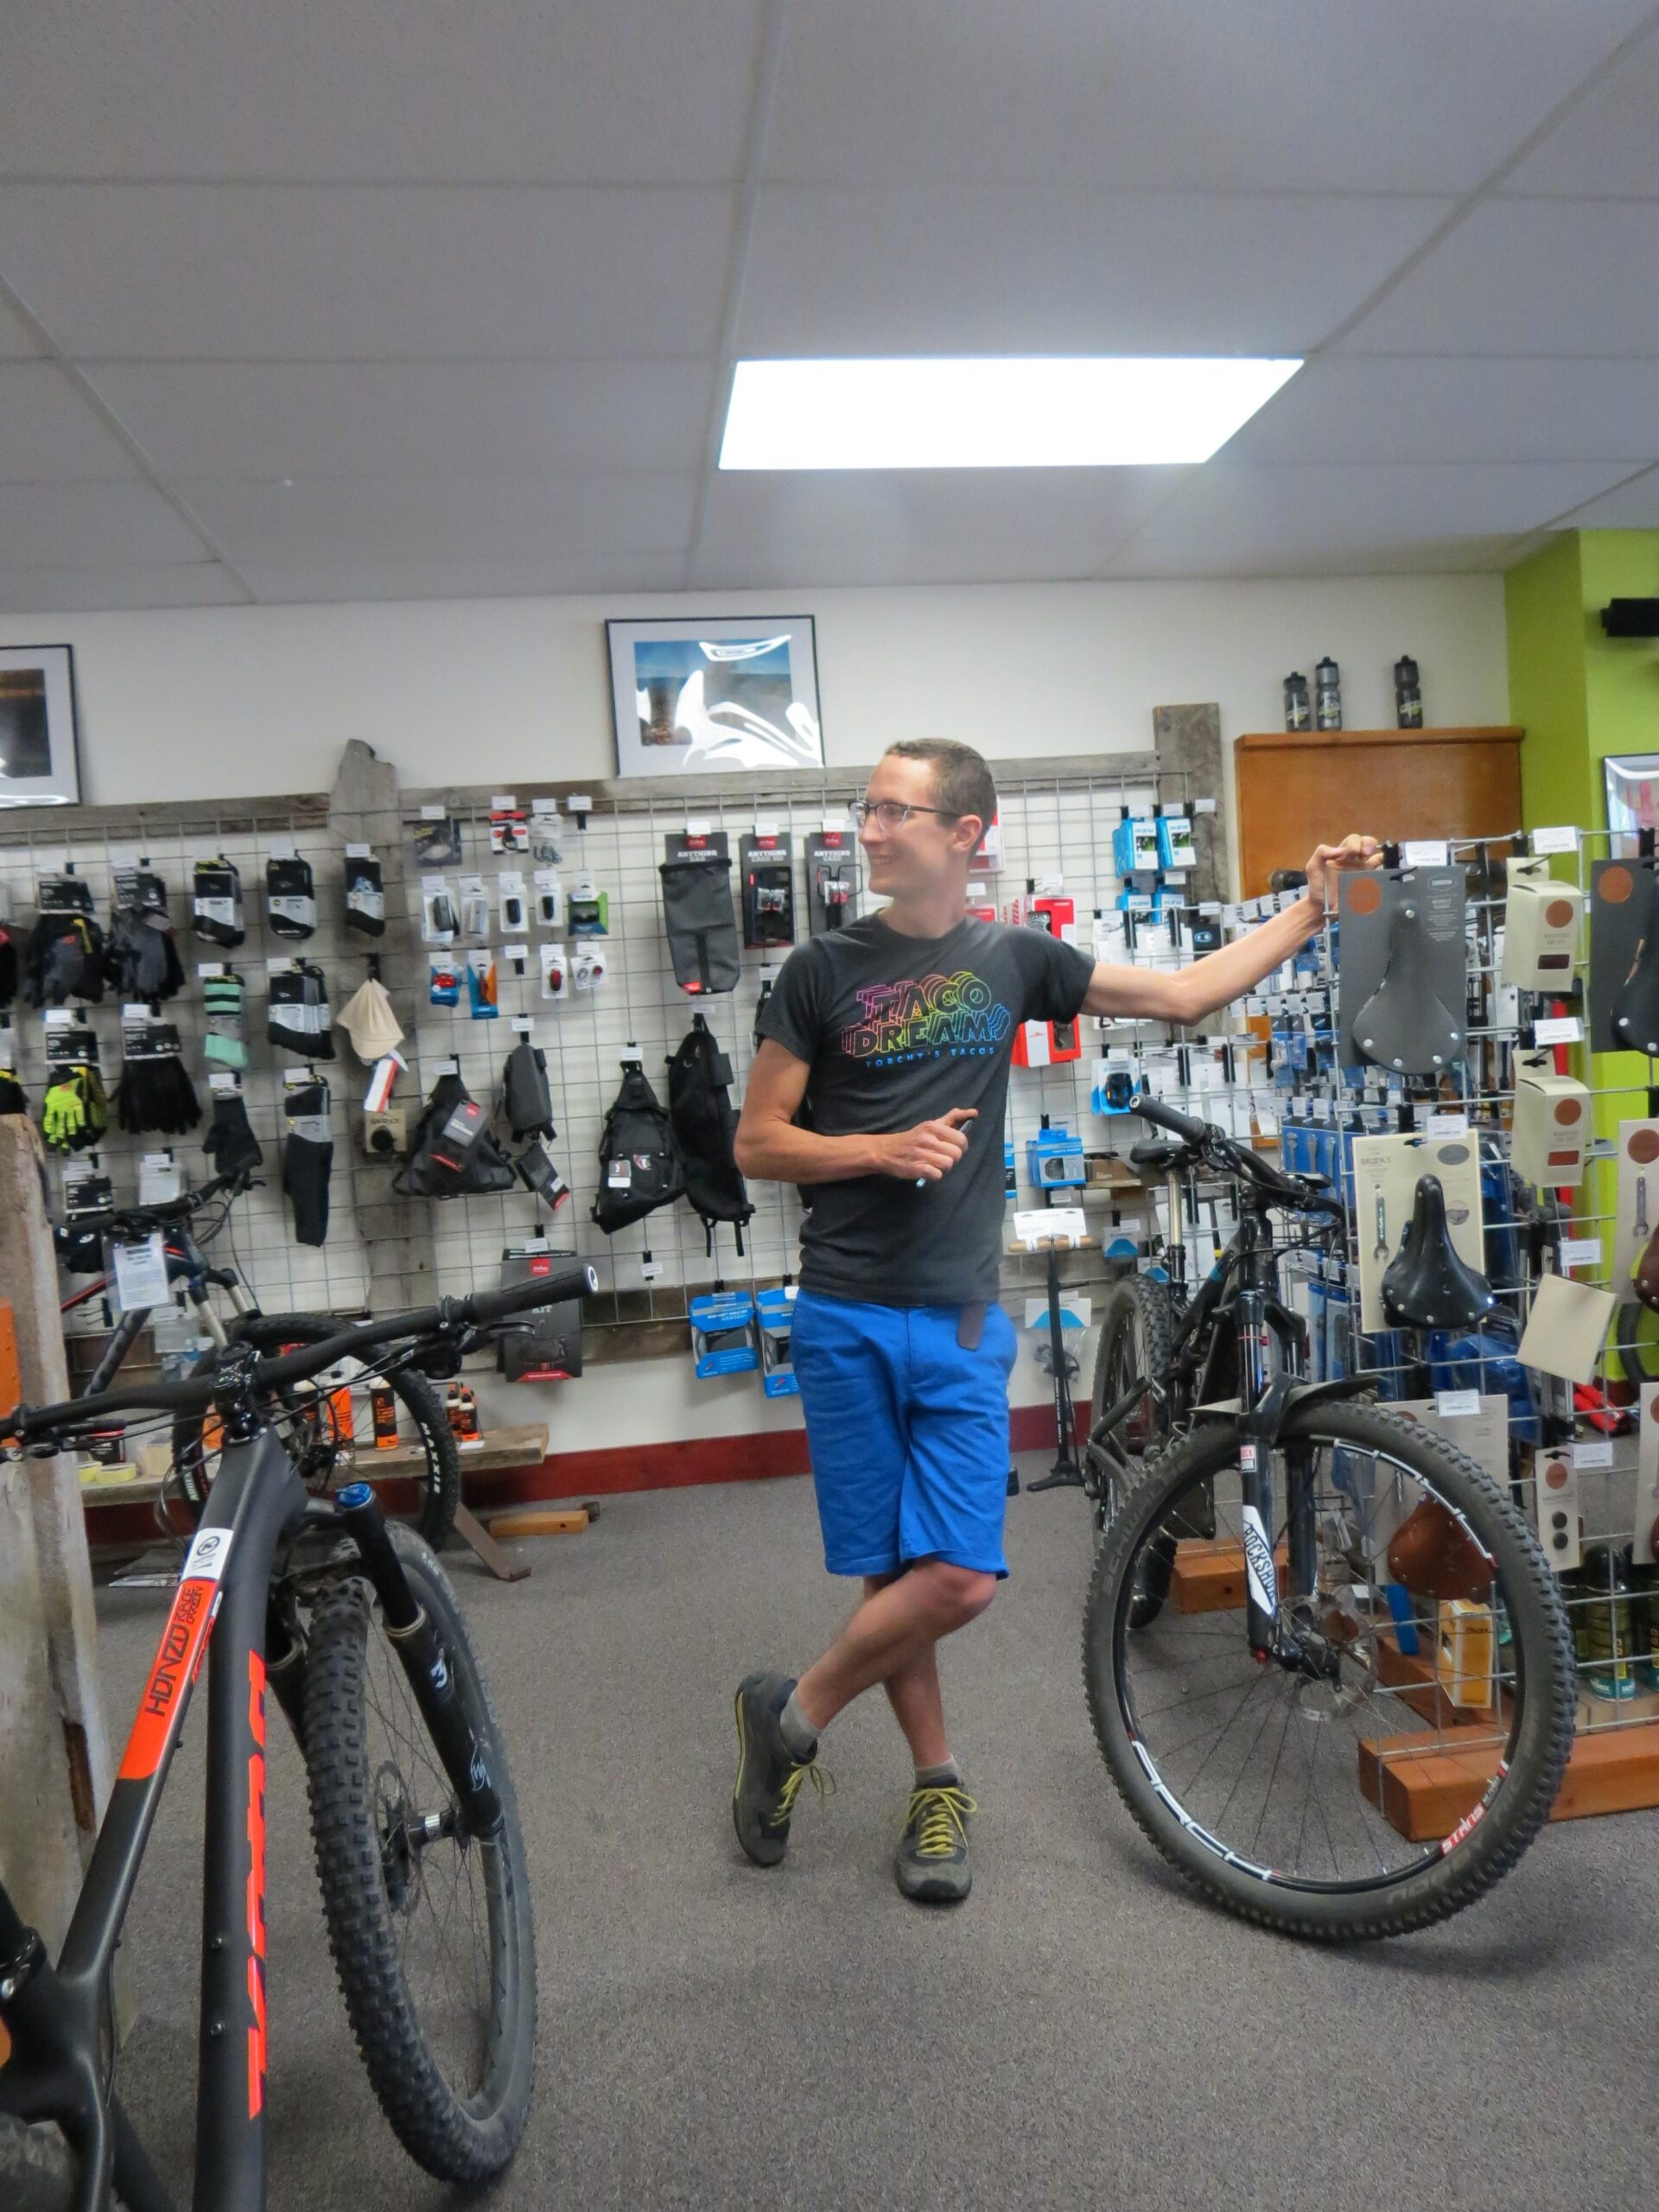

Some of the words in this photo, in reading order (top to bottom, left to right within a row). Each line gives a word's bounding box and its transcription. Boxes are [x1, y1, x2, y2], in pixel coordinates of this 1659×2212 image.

[856, 970, 992, 1023] TACO
[950, 1046, 995, 1057] TACOS
[1361, 1156, 1391, 1166] BROOKS
